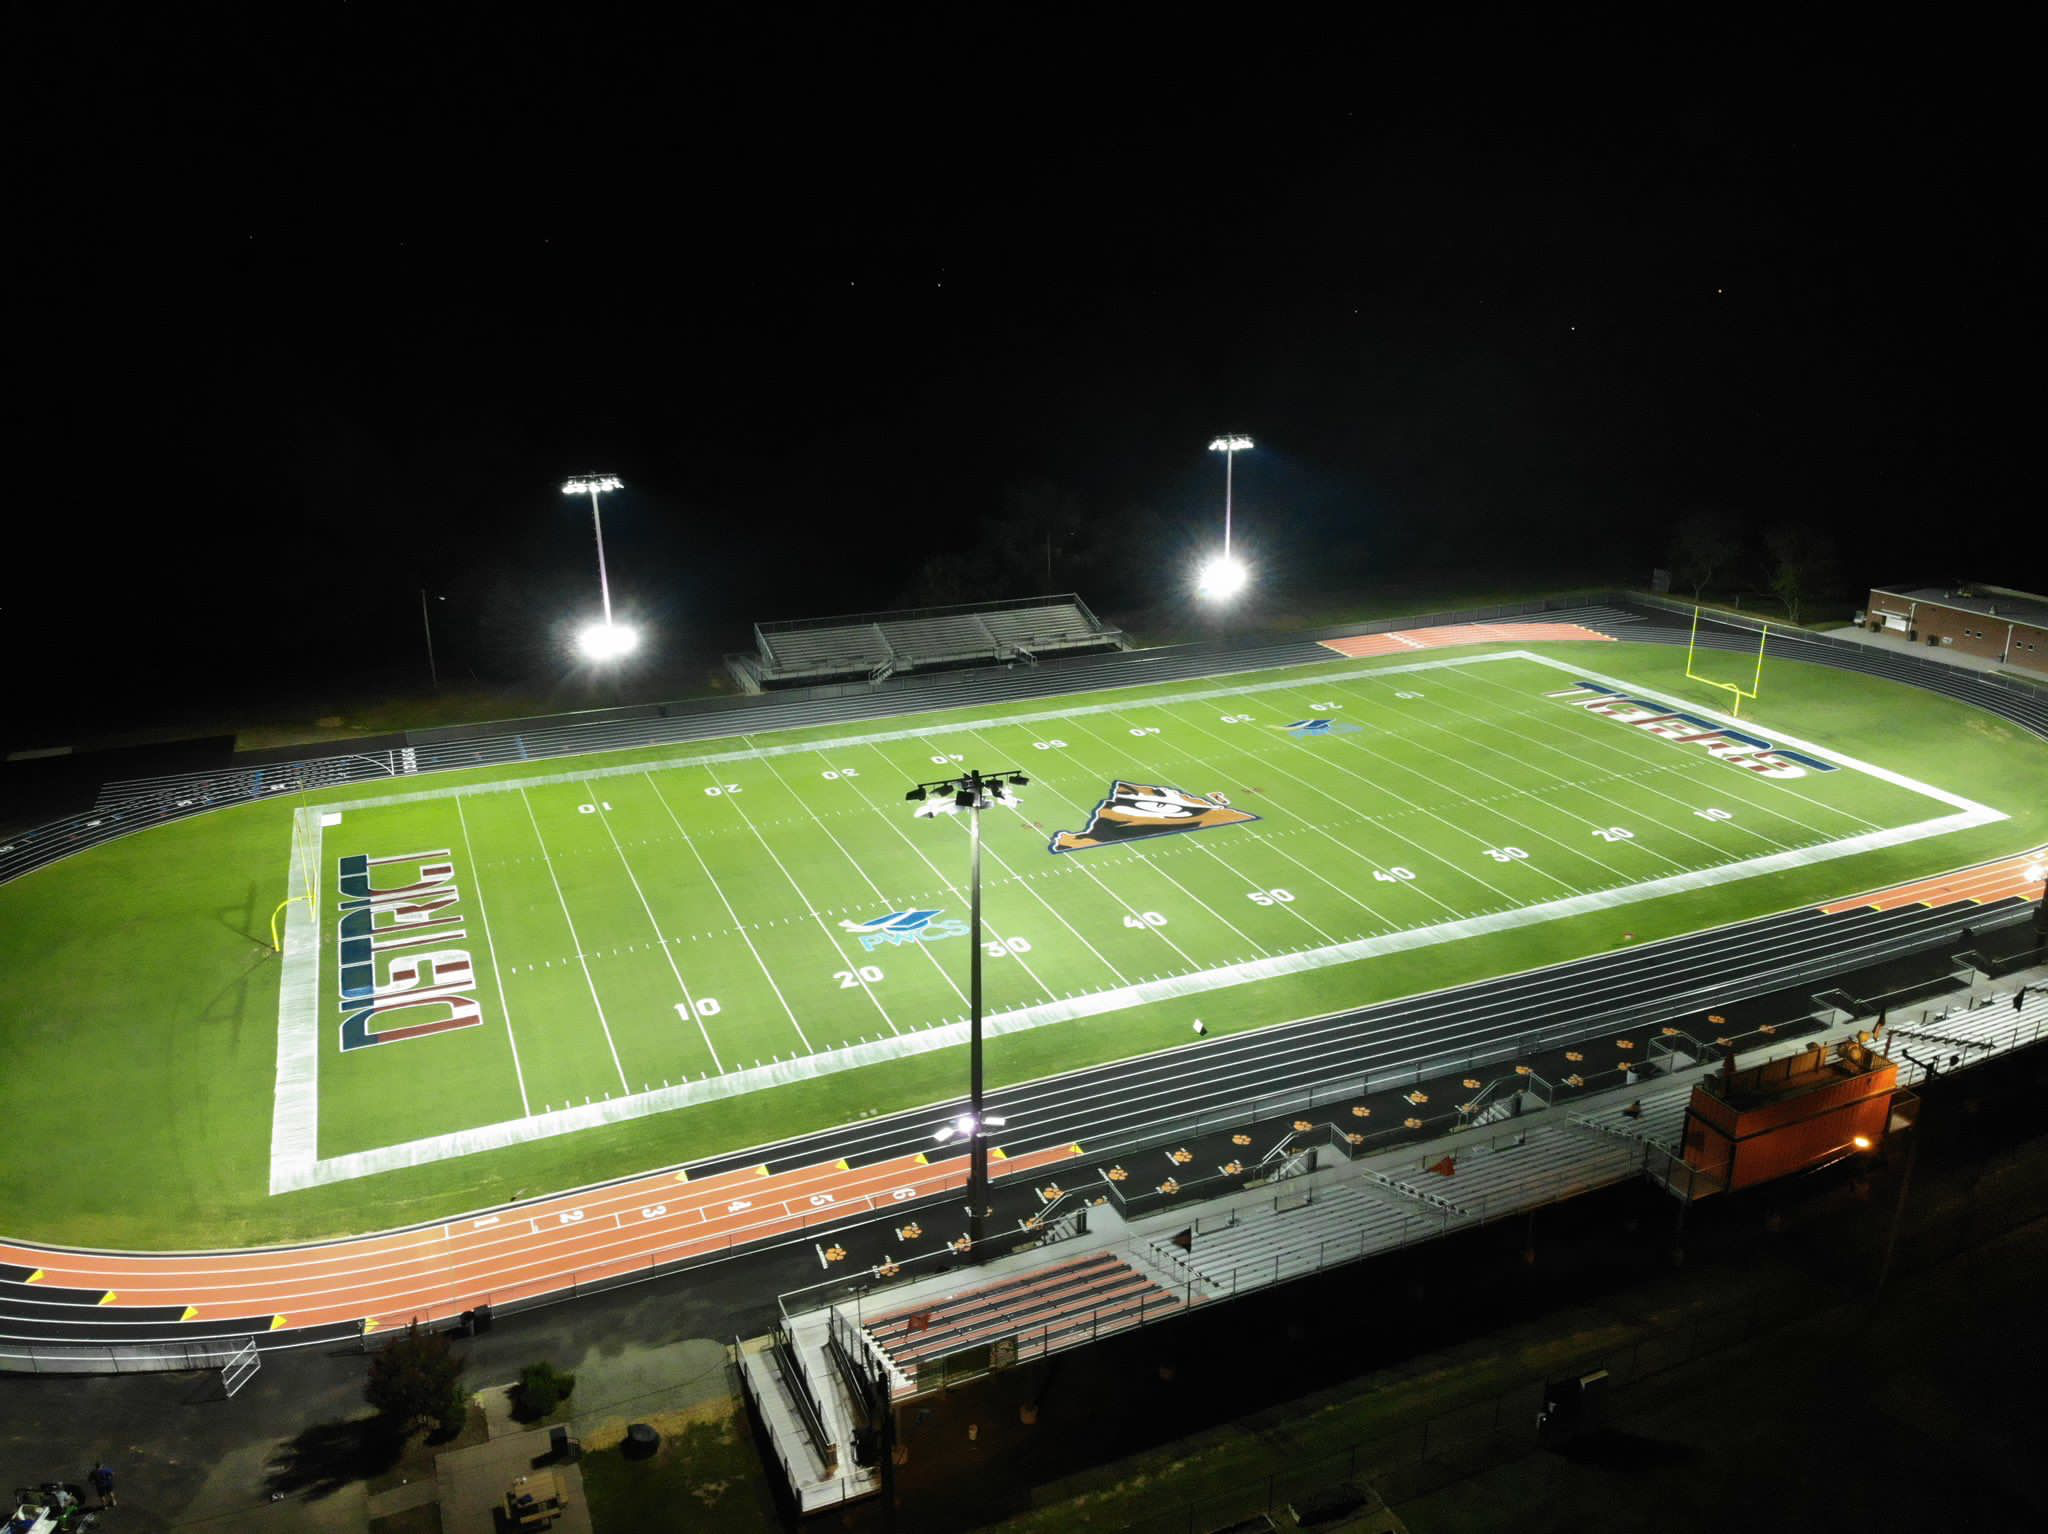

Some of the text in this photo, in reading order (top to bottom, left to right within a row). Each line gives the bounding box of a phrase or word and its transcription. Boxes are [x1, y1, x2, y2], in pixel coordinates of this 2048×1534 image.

[1543, 681, 1840, 779] TIGERS
[704, 783, 743, 797] 20
[577, 801, 613, 814] 10
[1693, 808, 1733, 822] 10
[1591, 827, 1635, 842] 20
[1482, 847, 1531, 862] 30
[1372, 866, 1416, 883] 40
[1246, 888, 1296, 906] 50
[1123, 911, 1168, 930] 40
[338, 848, 483, 1053] DISTRICT
[980, 936, 1032, 958] 30
[832, 965, 884, 989] 20
[673, 997, 721, 1021] 10
